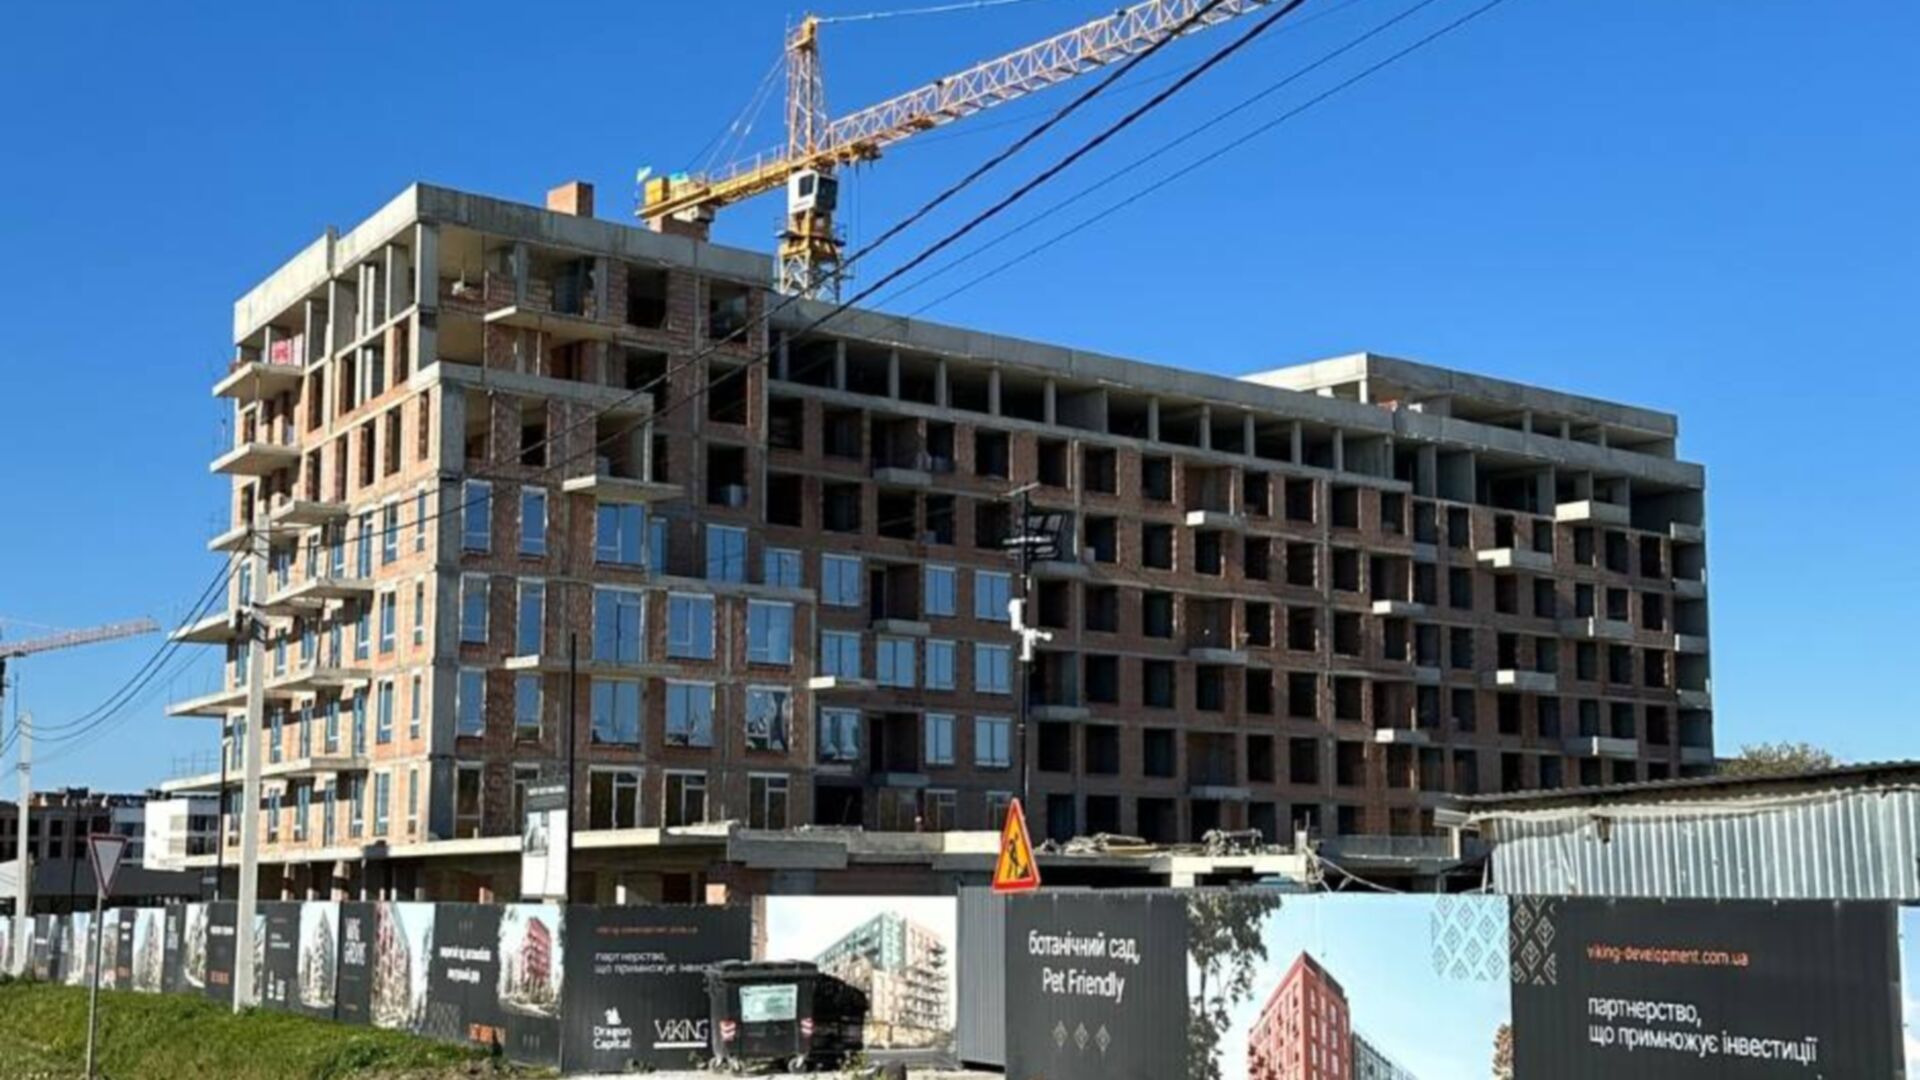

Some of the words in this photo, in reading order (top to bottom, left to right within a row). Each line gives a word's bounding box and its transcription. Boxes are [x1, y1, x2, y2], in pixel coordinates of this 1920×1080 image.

[1028, 929, 1106, 957] ботанічний
[1108, 937, 1141, 964] сад,
[1587, 945, 1750, 967] viking-development.com.ua
[1042, 967, 1065, 994] Pet
[1067, 968, 1125, 1003] Friendly
[1588, 997, 1702, 1028] партнерство,
[593, 1038, 631, 1051] Capital
[594, 1026, 632, 1038] Dragon
[1589, 1025, 1615, 1047] що
[1618, 1027, 1719, 1058] примножує
[1722, 1031, 1818, 1065] інвестиції
